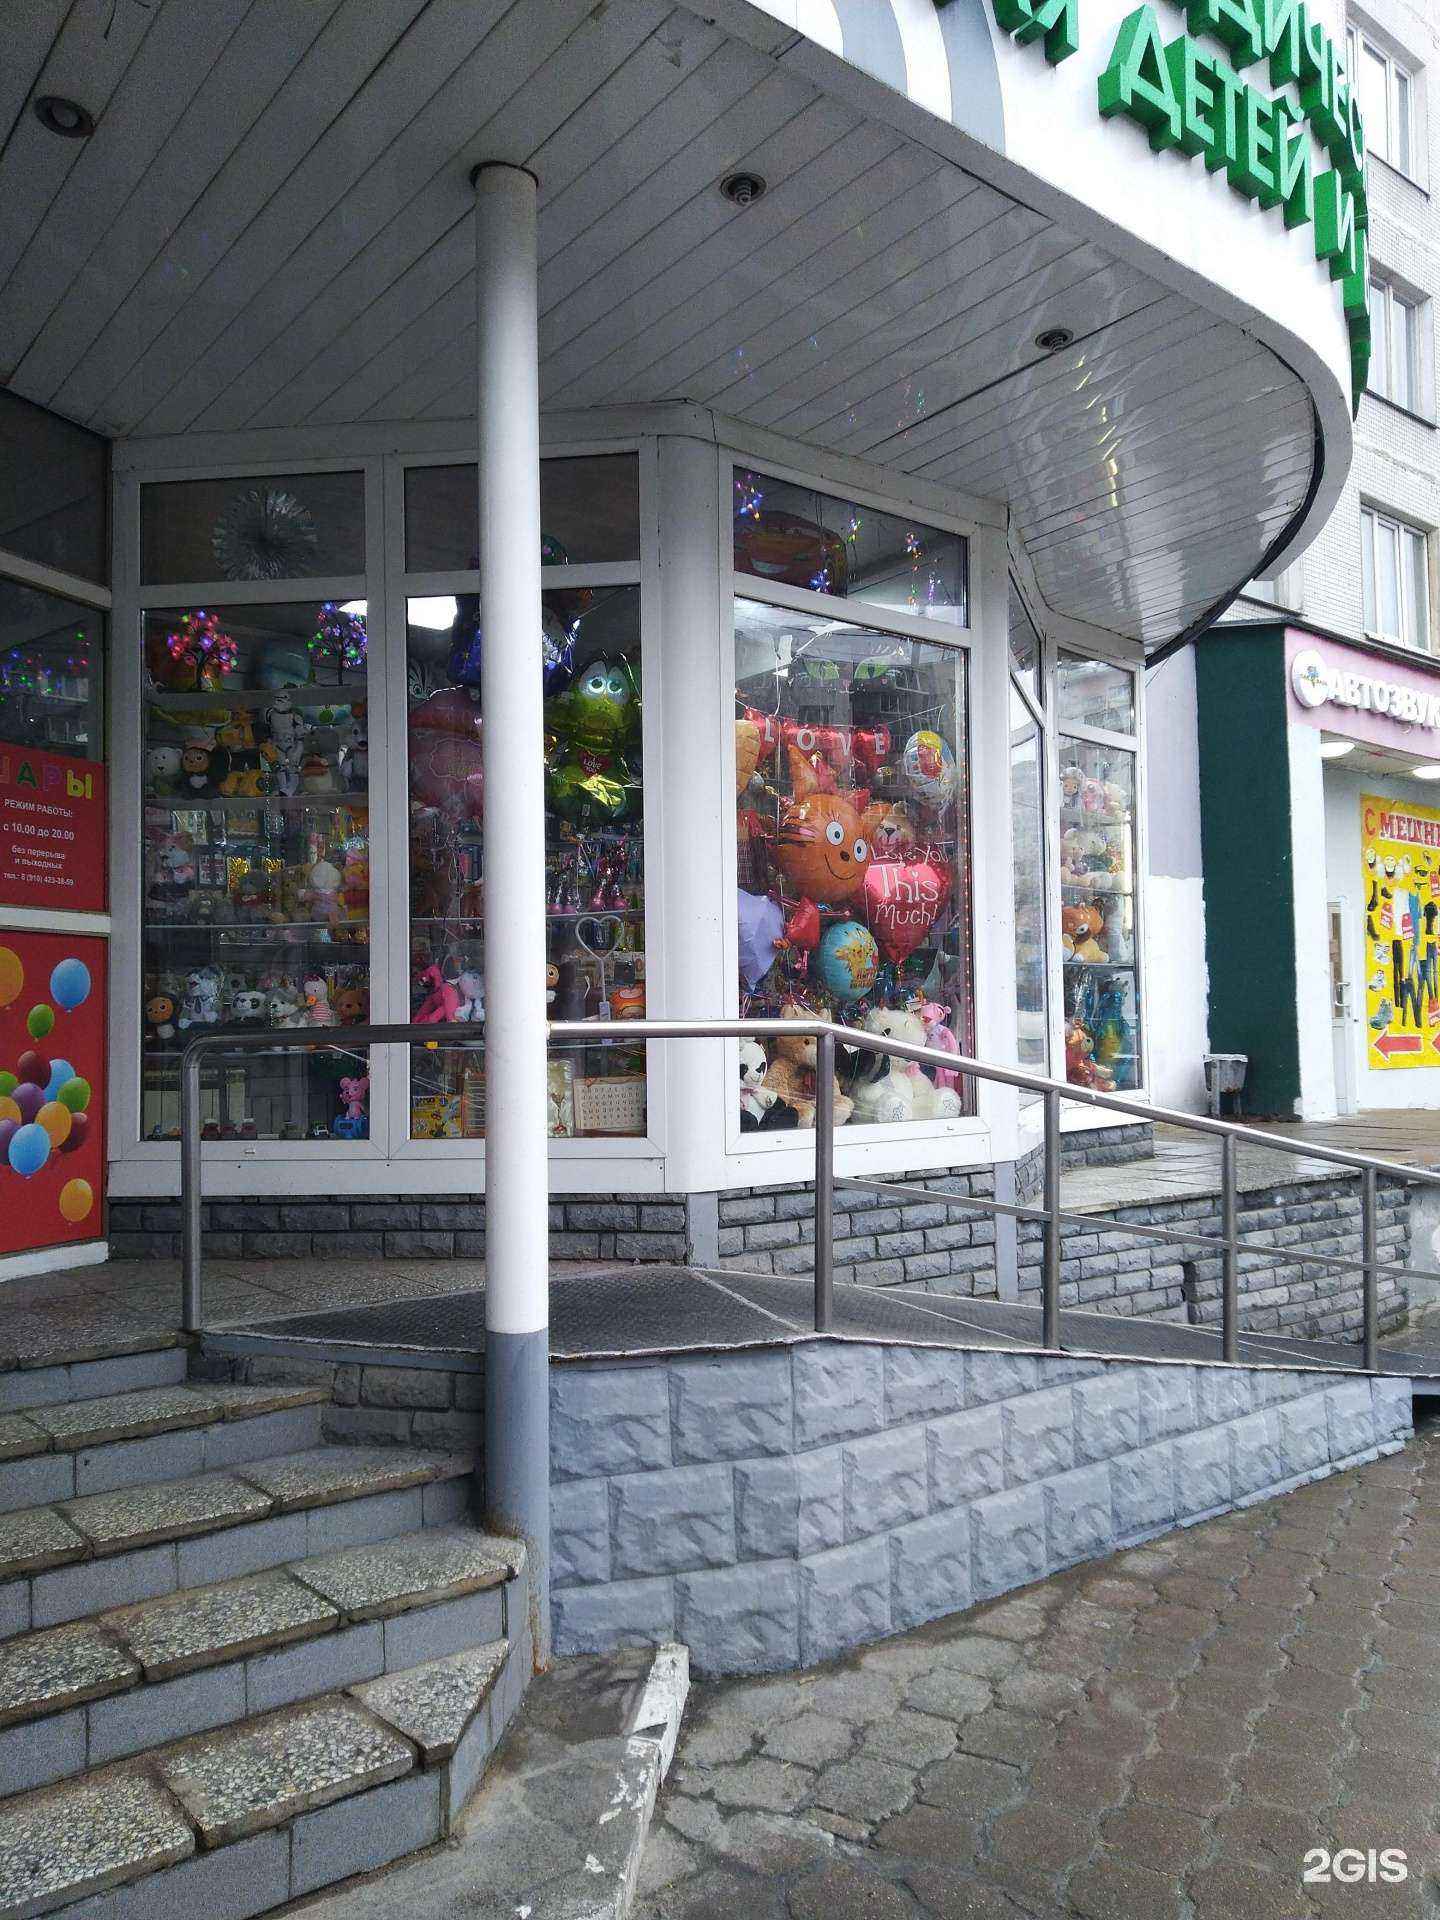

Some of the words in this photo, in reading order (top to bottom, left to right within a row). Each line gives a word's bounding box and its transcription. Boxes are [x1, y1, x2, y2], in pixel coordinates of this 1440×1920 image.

[1100, 3, 1312, 229] ДЕТЕЙ
[765, 718, 886, 756] LOVE
[4, 799, 35, 811] РЕЖИМ
[37, 804, 73, 818] РАБОТЫ:
[37, 828, 50, 838] до
[868, 862, 939, 903] This
